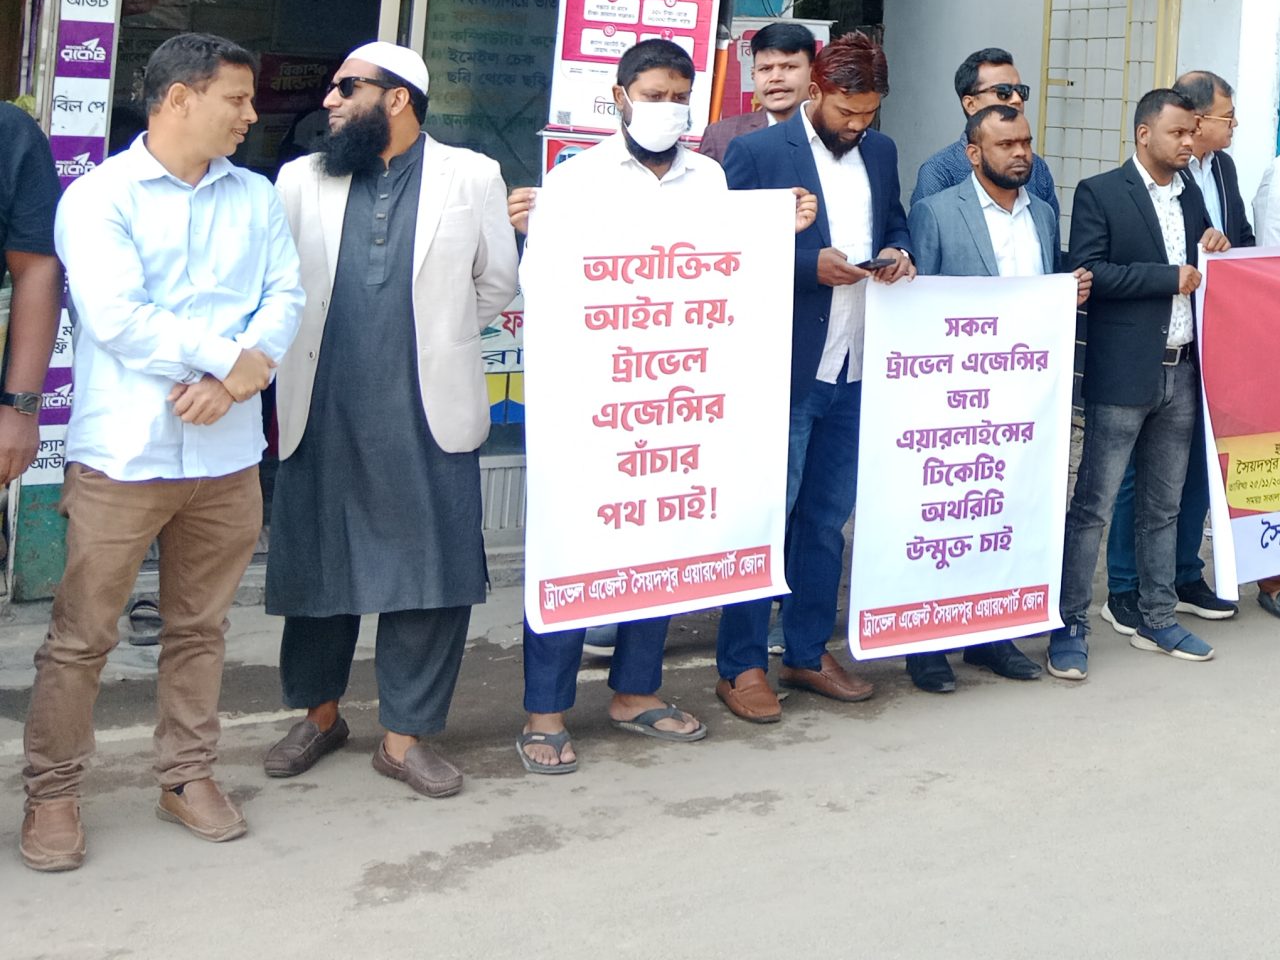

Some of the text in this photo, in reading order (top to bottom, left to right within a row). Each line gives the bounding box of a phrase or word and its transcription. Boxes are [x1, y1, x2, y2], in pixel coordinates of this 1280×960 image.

[53, 95, 106, 113] বিল পে
[583, 242, 741, 284] অযৌক্তিক
[584, 296, 735, 330] আইন নয়,
[944, 316, 998, 337] সকল
[611, 346, 708, 383] ট্রাভেল
[886, 343, 1049, 380] ট্রাভেল এজেন্সির
[592, 385, 725, 432] এজেন্সির
[946, 388, 990, 410] জন্য
[896, 419, 1034, 453] এয়ারলাইন্সের
[617, 438, 700, 477] বাঁচার
[923, 457, 1006, 486] টিকেটিং
[1236, 457, 1280, 474] সৈয়দপুর
[597, 485, 718, 529] পথ চাই!
[921, 489, 1004, 522] অথরিটি
[905, 526, 1013, 570] উন্মুক্ত চাই
[544, 551, 766, 611] ট্রাভেল এজেন্ট সৈয়দপুর এয়ারপোর্ট জোন
[862, 590, 1045, 637] ট্রাভেল সৈয়দপুর জোন
